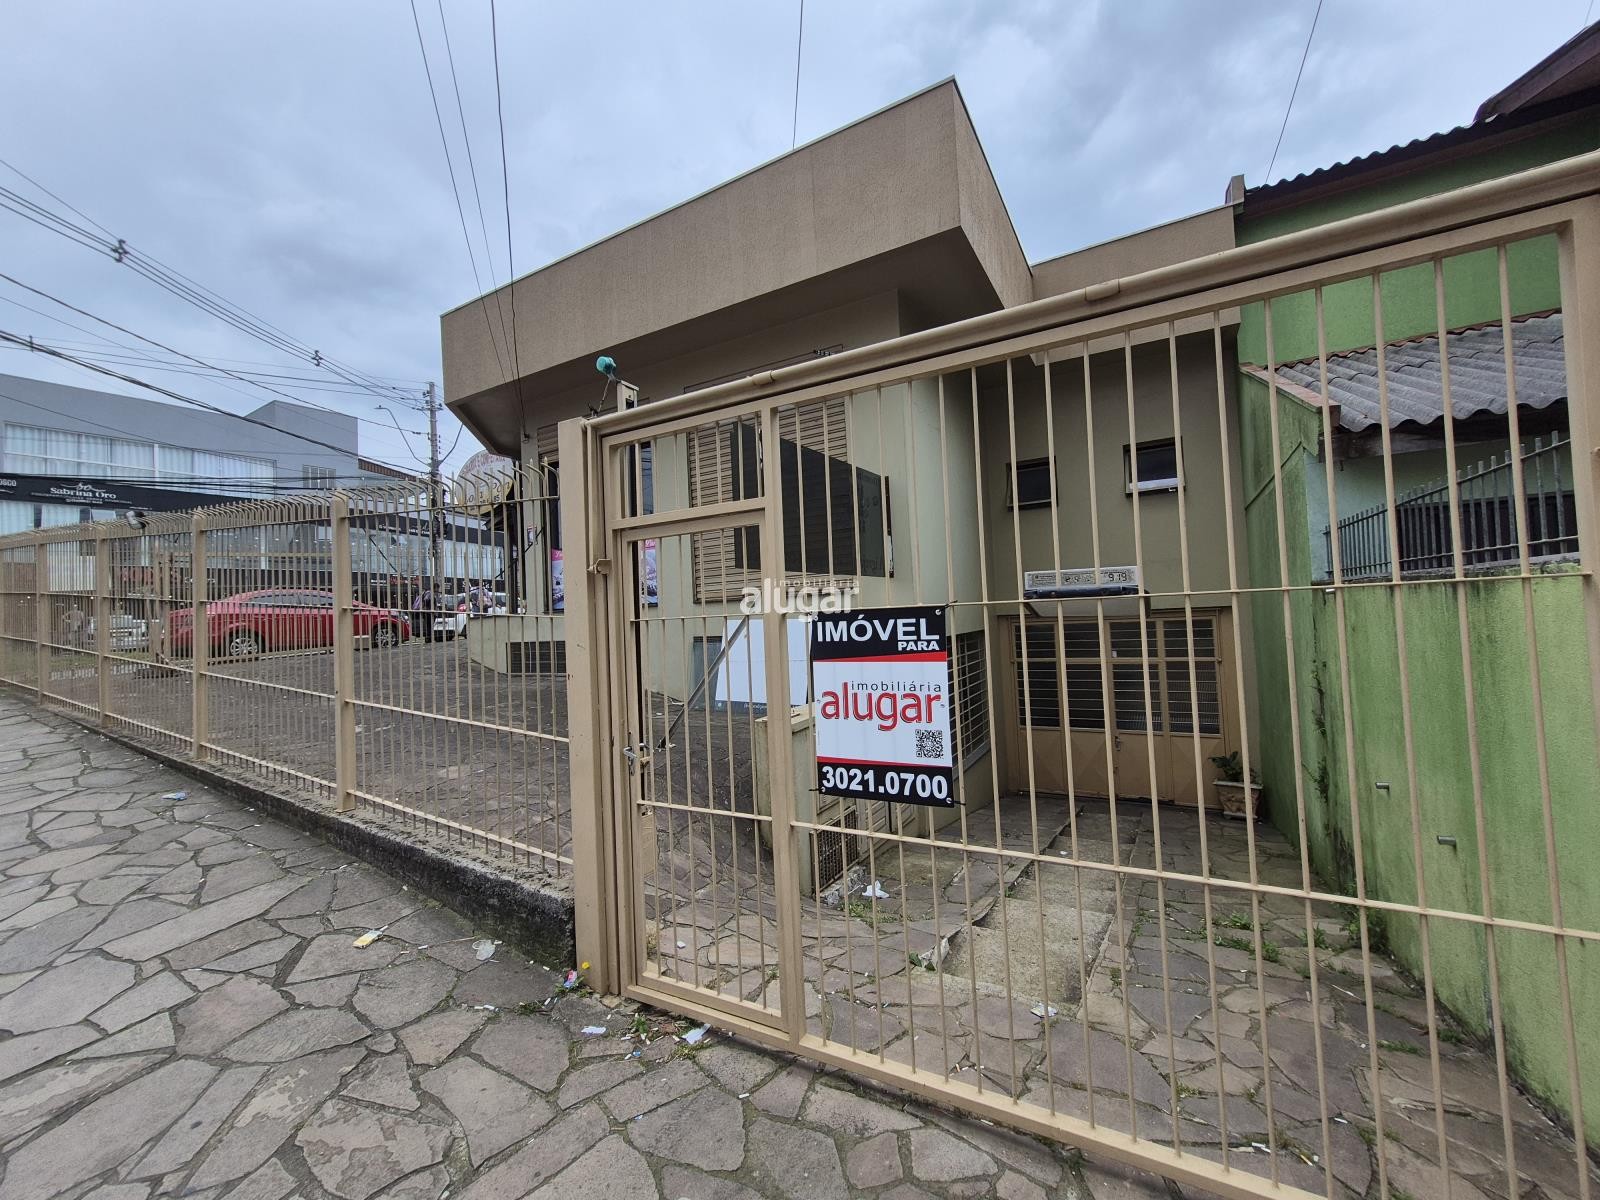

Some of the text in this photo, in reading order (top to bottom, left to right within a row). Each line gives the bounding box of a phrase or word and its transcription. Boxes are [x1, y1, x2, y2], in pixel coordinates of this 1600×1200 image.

[50, 487, 93, 497] Sabrina
[95, 489, 117, 499] Oro
[818, 614, 940, 642] IMÓVEL
[898, 641, 940, 651] PARA
[851, 681, 941, 692] imobiliária
[821, 682, 941, 731] alugar
[822, 766, 948, 799] 3021.0700
